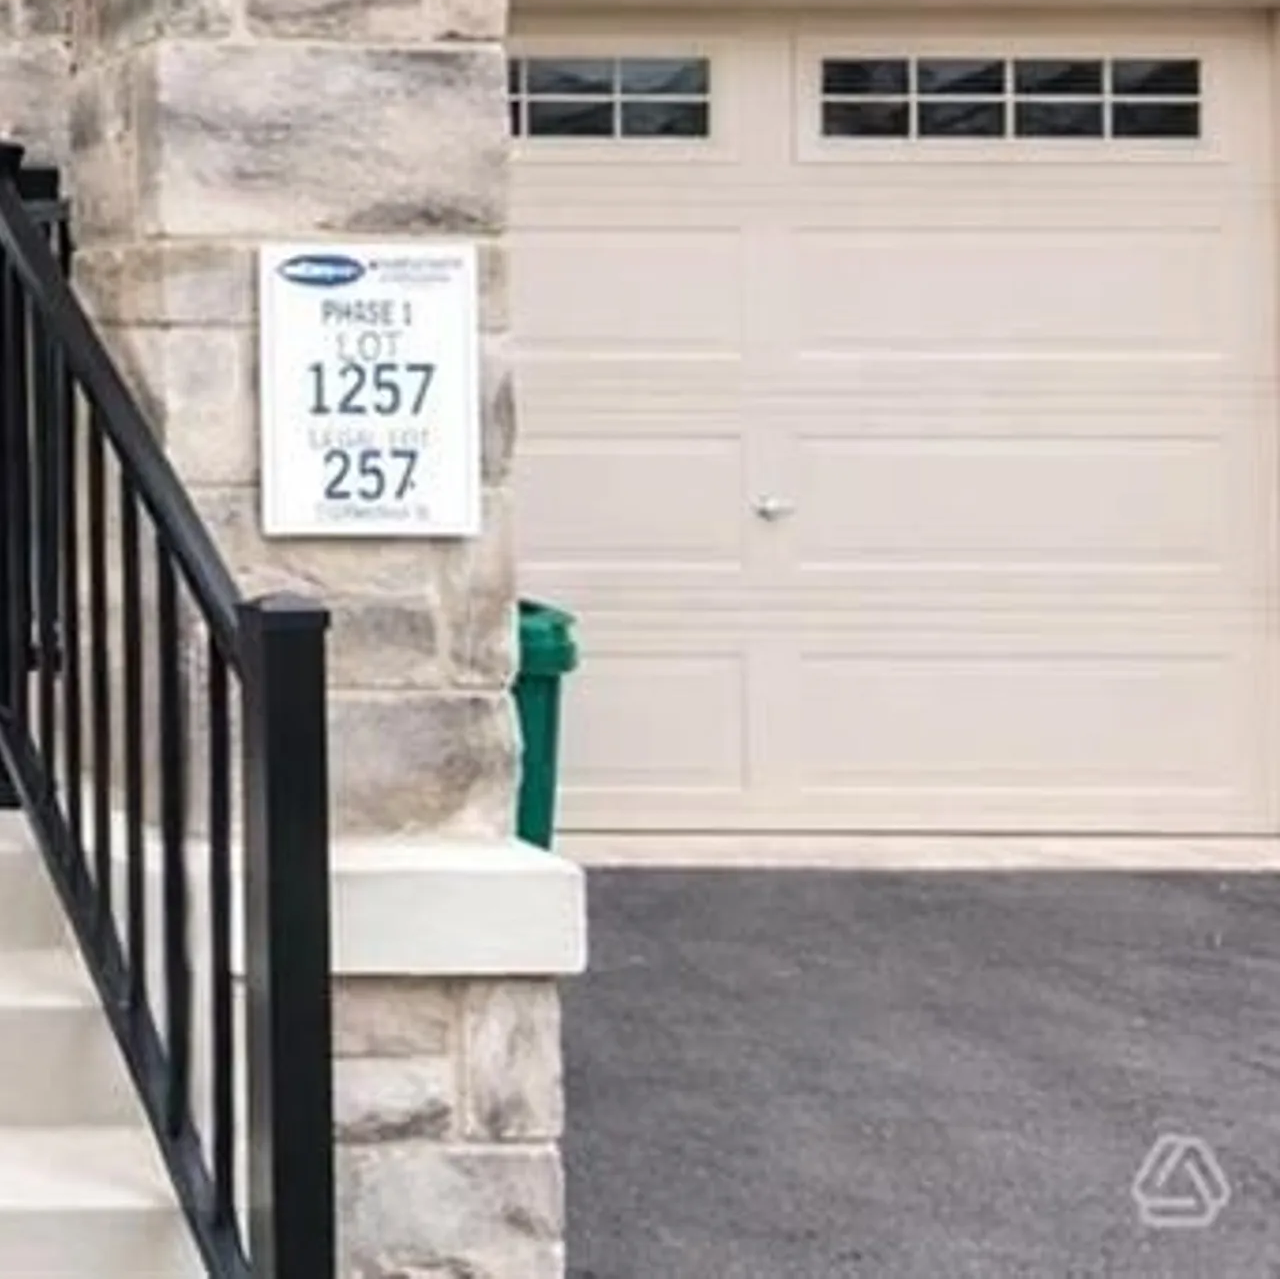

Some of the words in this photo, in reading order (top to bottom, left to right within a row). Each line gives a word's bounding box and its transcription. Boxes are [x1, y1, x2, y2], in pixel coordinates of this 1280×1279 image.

[321, 299, 395, 325] PHASE
[402, 300, 413, 326] 1
[336, 330, 402, 362] LOT
[308, 362, 437, 417] 1257
[323, 446, 419, 501] 257
